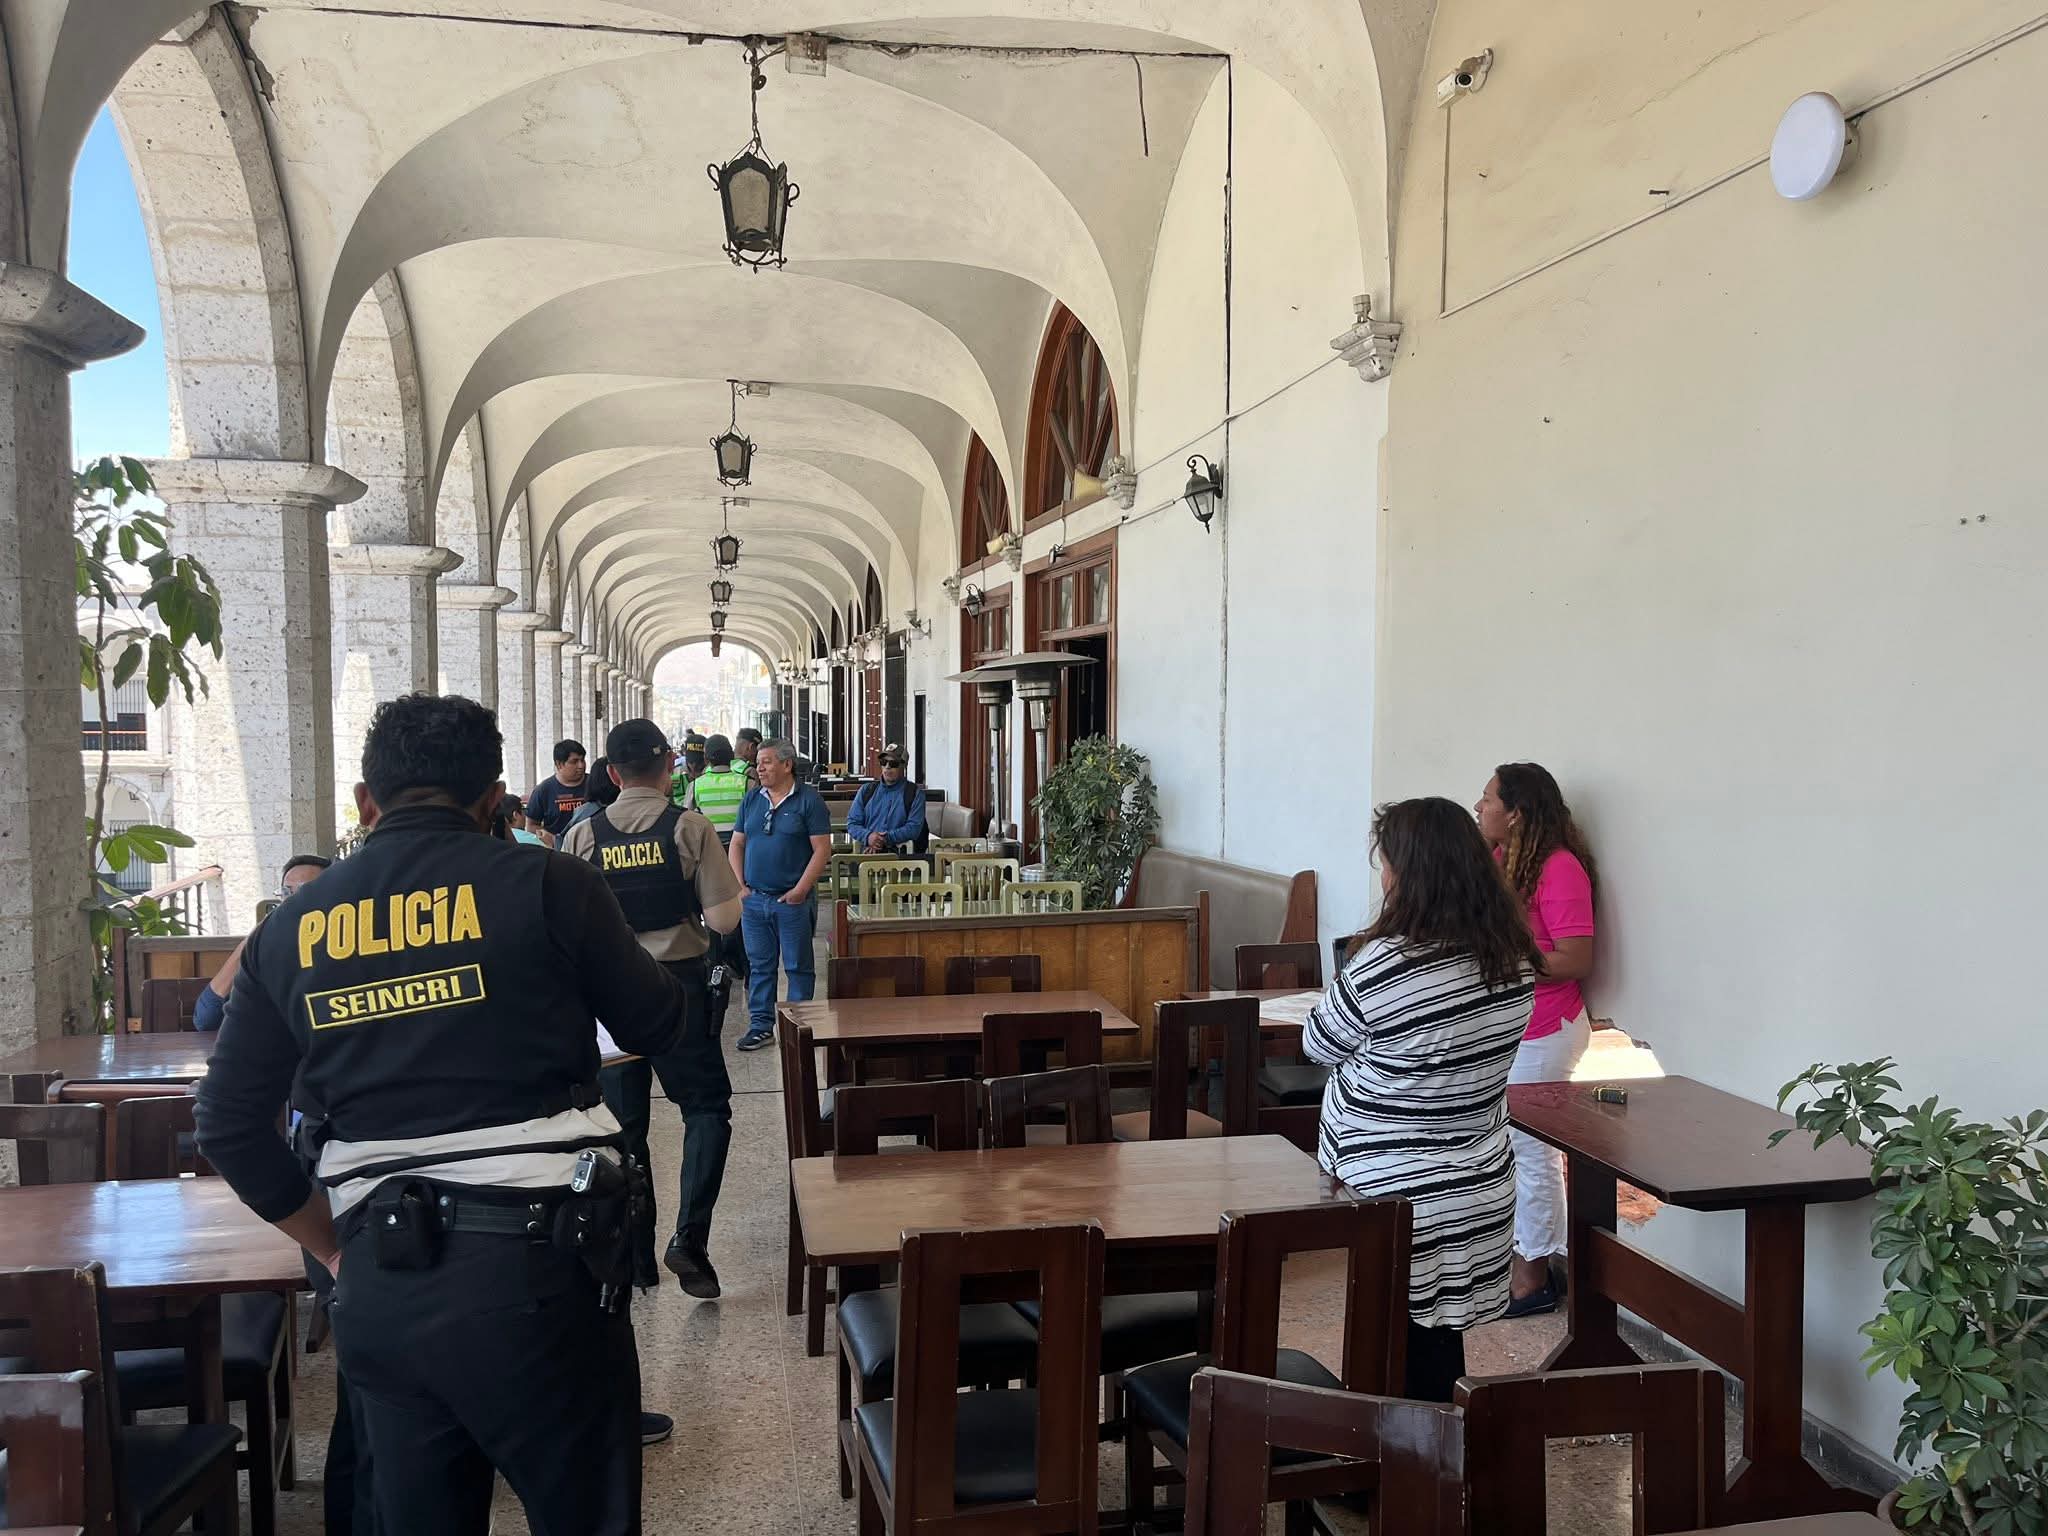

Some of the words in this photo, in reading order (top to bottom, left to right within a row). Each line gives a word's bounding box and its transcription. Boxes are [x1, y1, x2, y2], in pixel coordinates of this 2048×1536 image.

[601, 841, 665, 871] POLICIA
[298, 884, 483, 969] POLICÍA
[328, 975, 462, 1019] SEINCRI
